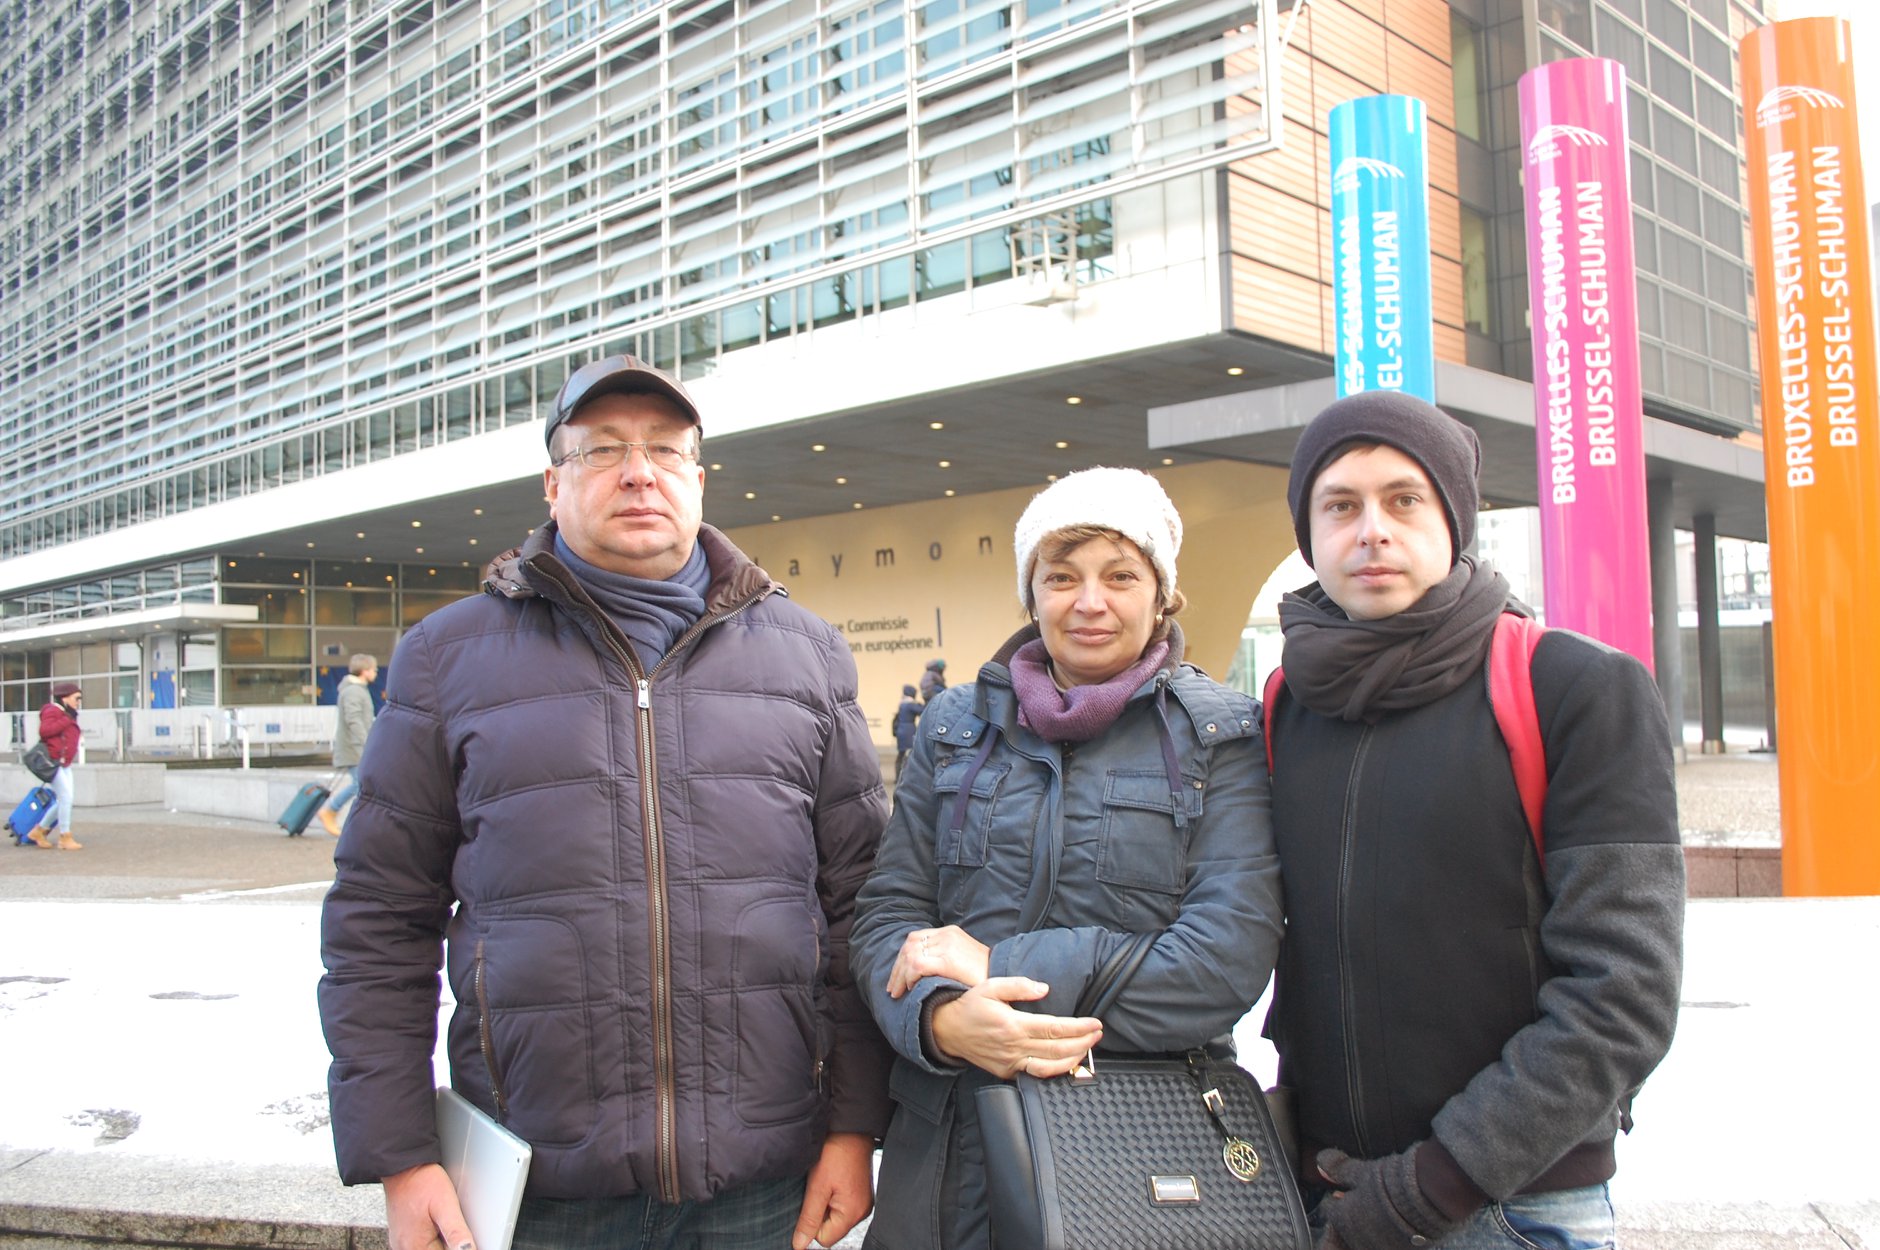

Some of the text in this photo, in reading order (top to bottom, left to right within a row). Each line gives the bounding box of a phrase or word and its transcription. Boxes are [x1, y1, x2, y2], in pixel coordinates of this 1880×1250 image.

[1372, 211, 1404, 392] EL-SCHUMAN
[1538, 186, 1576, 504] BRUXELLES-SCHUMAN
[1576, 181, 1616, 466] BRUSSEL-SCHUMAN
[1767, 151, 1814, 488] BRUXELLES-SCHUMAN
[1812, 145, 1858, 447] BRUSSEL-SCHUMAN
[847, 616, 909, 633] Commissie
[865, 635, 933, 654] européenne
